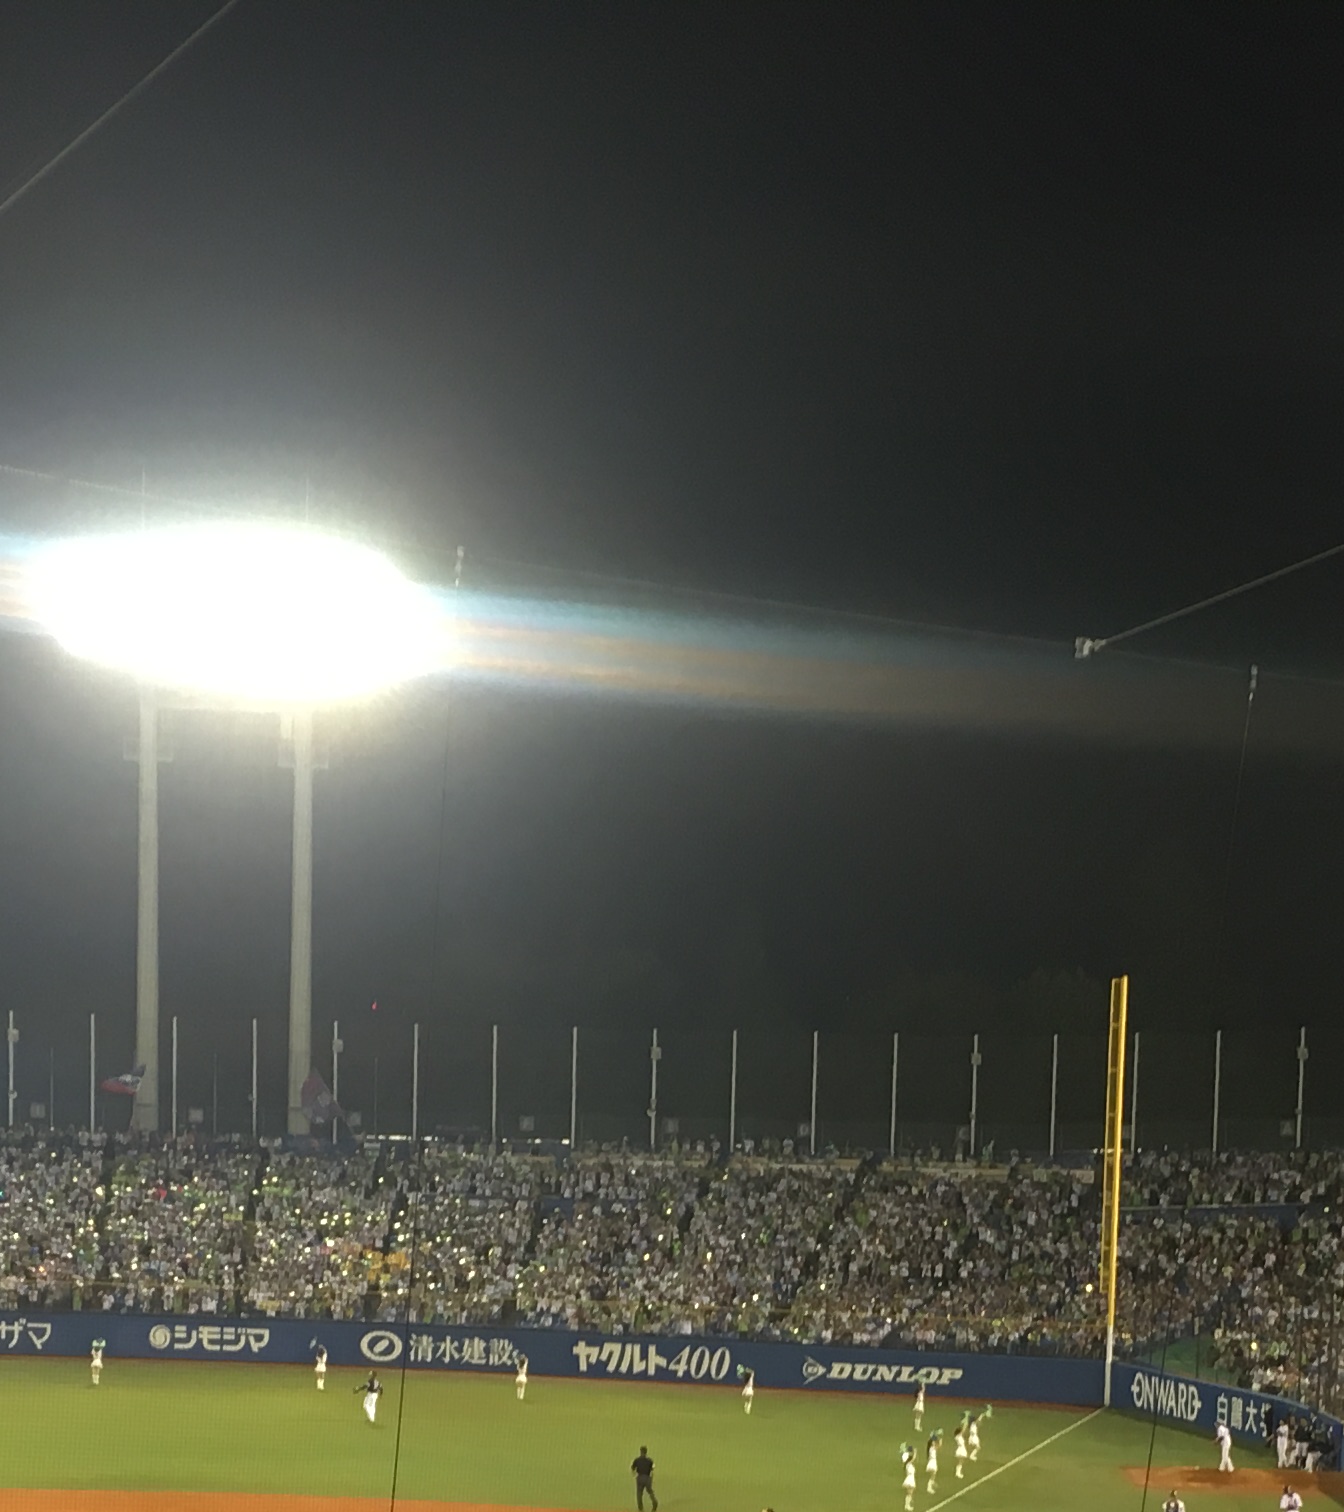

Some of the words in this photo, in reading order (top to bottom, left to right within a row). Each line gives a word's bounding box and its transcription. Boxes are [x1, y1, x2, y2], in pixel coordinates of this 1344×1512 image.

[174, 1325, 270, 1352] シモジマ
[409, 1334, 514, 1367] 清水建設
[572, 1340, 731, 1380] ヤクルト400
[826, 1361, 963, 1386] DUNLOP
[1130, 1371, 1202, 1421] ONWARD
